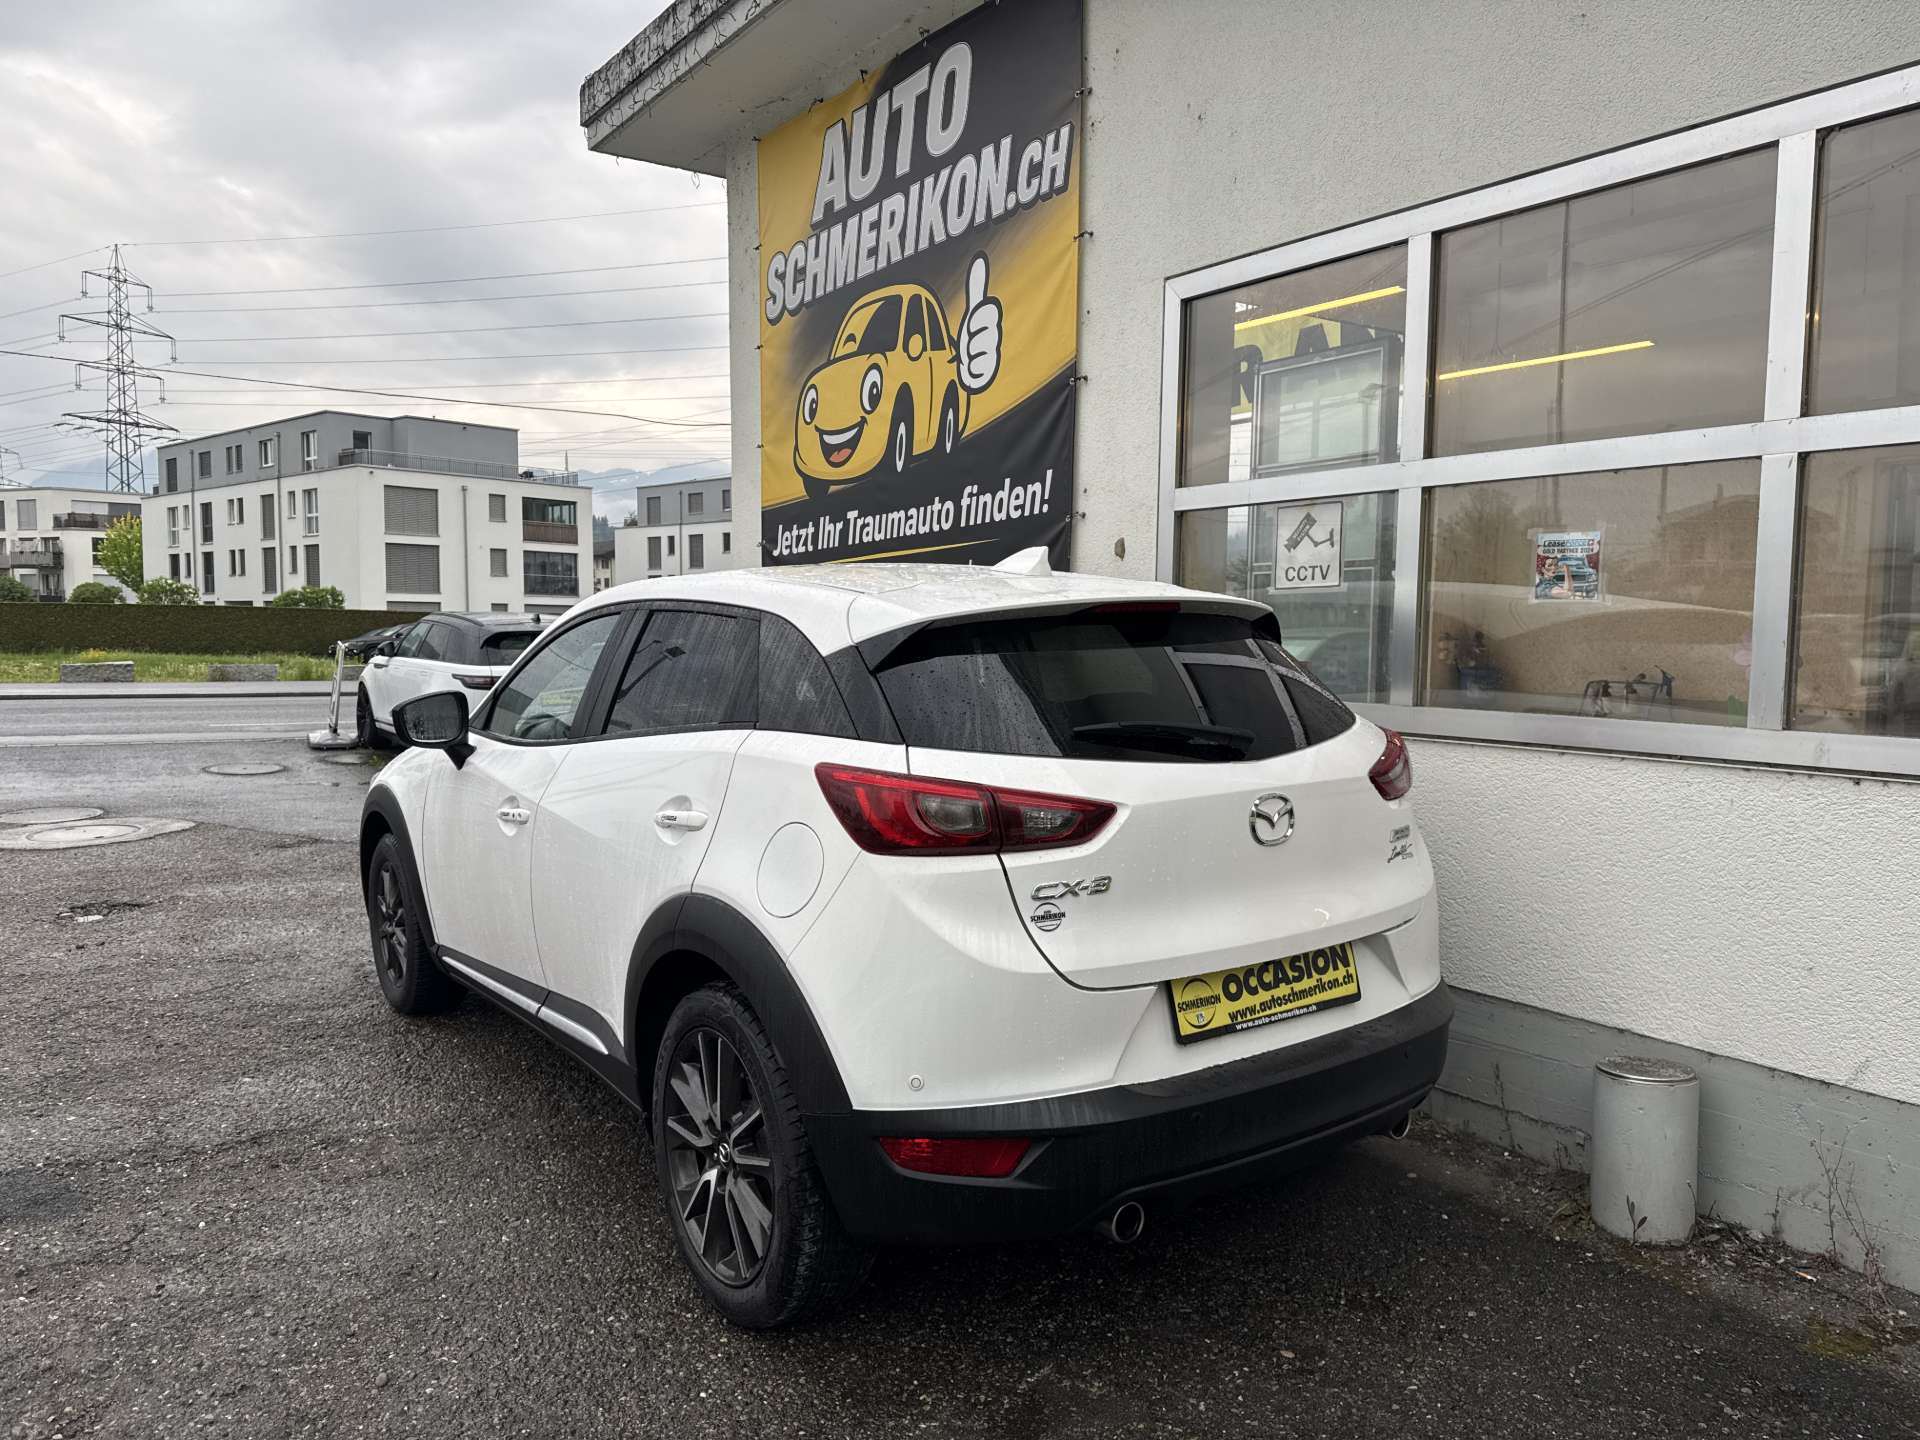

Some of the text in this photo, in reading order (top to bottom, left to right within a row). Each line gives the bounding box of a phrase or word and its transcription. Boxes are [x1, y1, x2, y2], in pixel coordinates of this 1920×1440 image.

[811, 41, 973, 226] AUTO
[765, 122, 1073, 322] SCHMERIKON.CH
[772, 469, 1053, 557] Jetzt Ihr Traumauto finden!
[1285, 564, 1331, 582] CCTV
[1031, 876, 1112, 900] CX-3
[1222, 942, 1350, 1002] OCCASION
[1228, 969, 1354, 1022] www.autoschmerikon.ch
[1178, 994, 1221, 1012] SCHMERIKON
